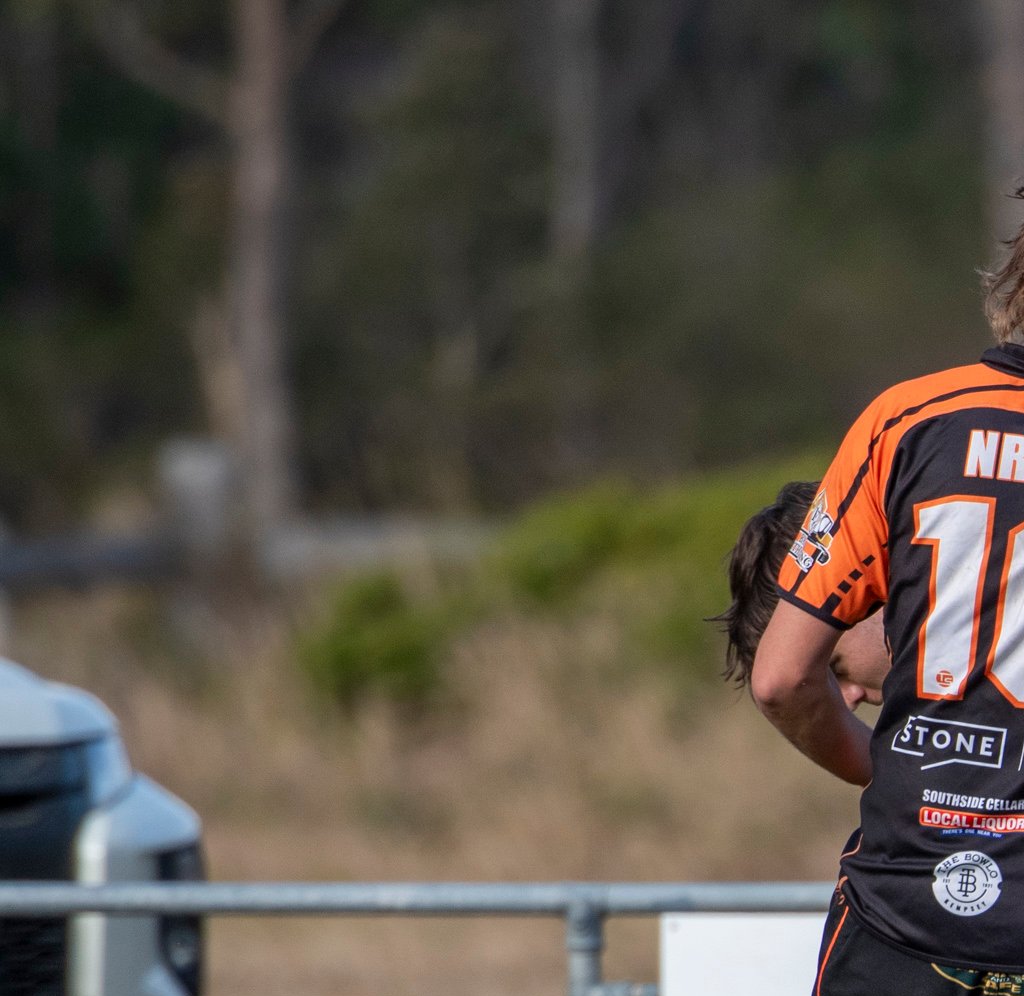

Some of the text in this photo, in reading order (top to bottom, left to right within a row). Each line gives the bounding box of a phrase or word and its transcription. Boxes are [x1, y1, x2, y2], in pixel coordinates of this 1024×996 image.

[900, 724, 995, 757] STONE
[922, 789, 985, 809] SOUTHSIDE
[923, 810, 970, 827] LOCAL
[937, 853, 999, 879] THE BOWLO
[943, 899, 987, 912] KEMPSEY
